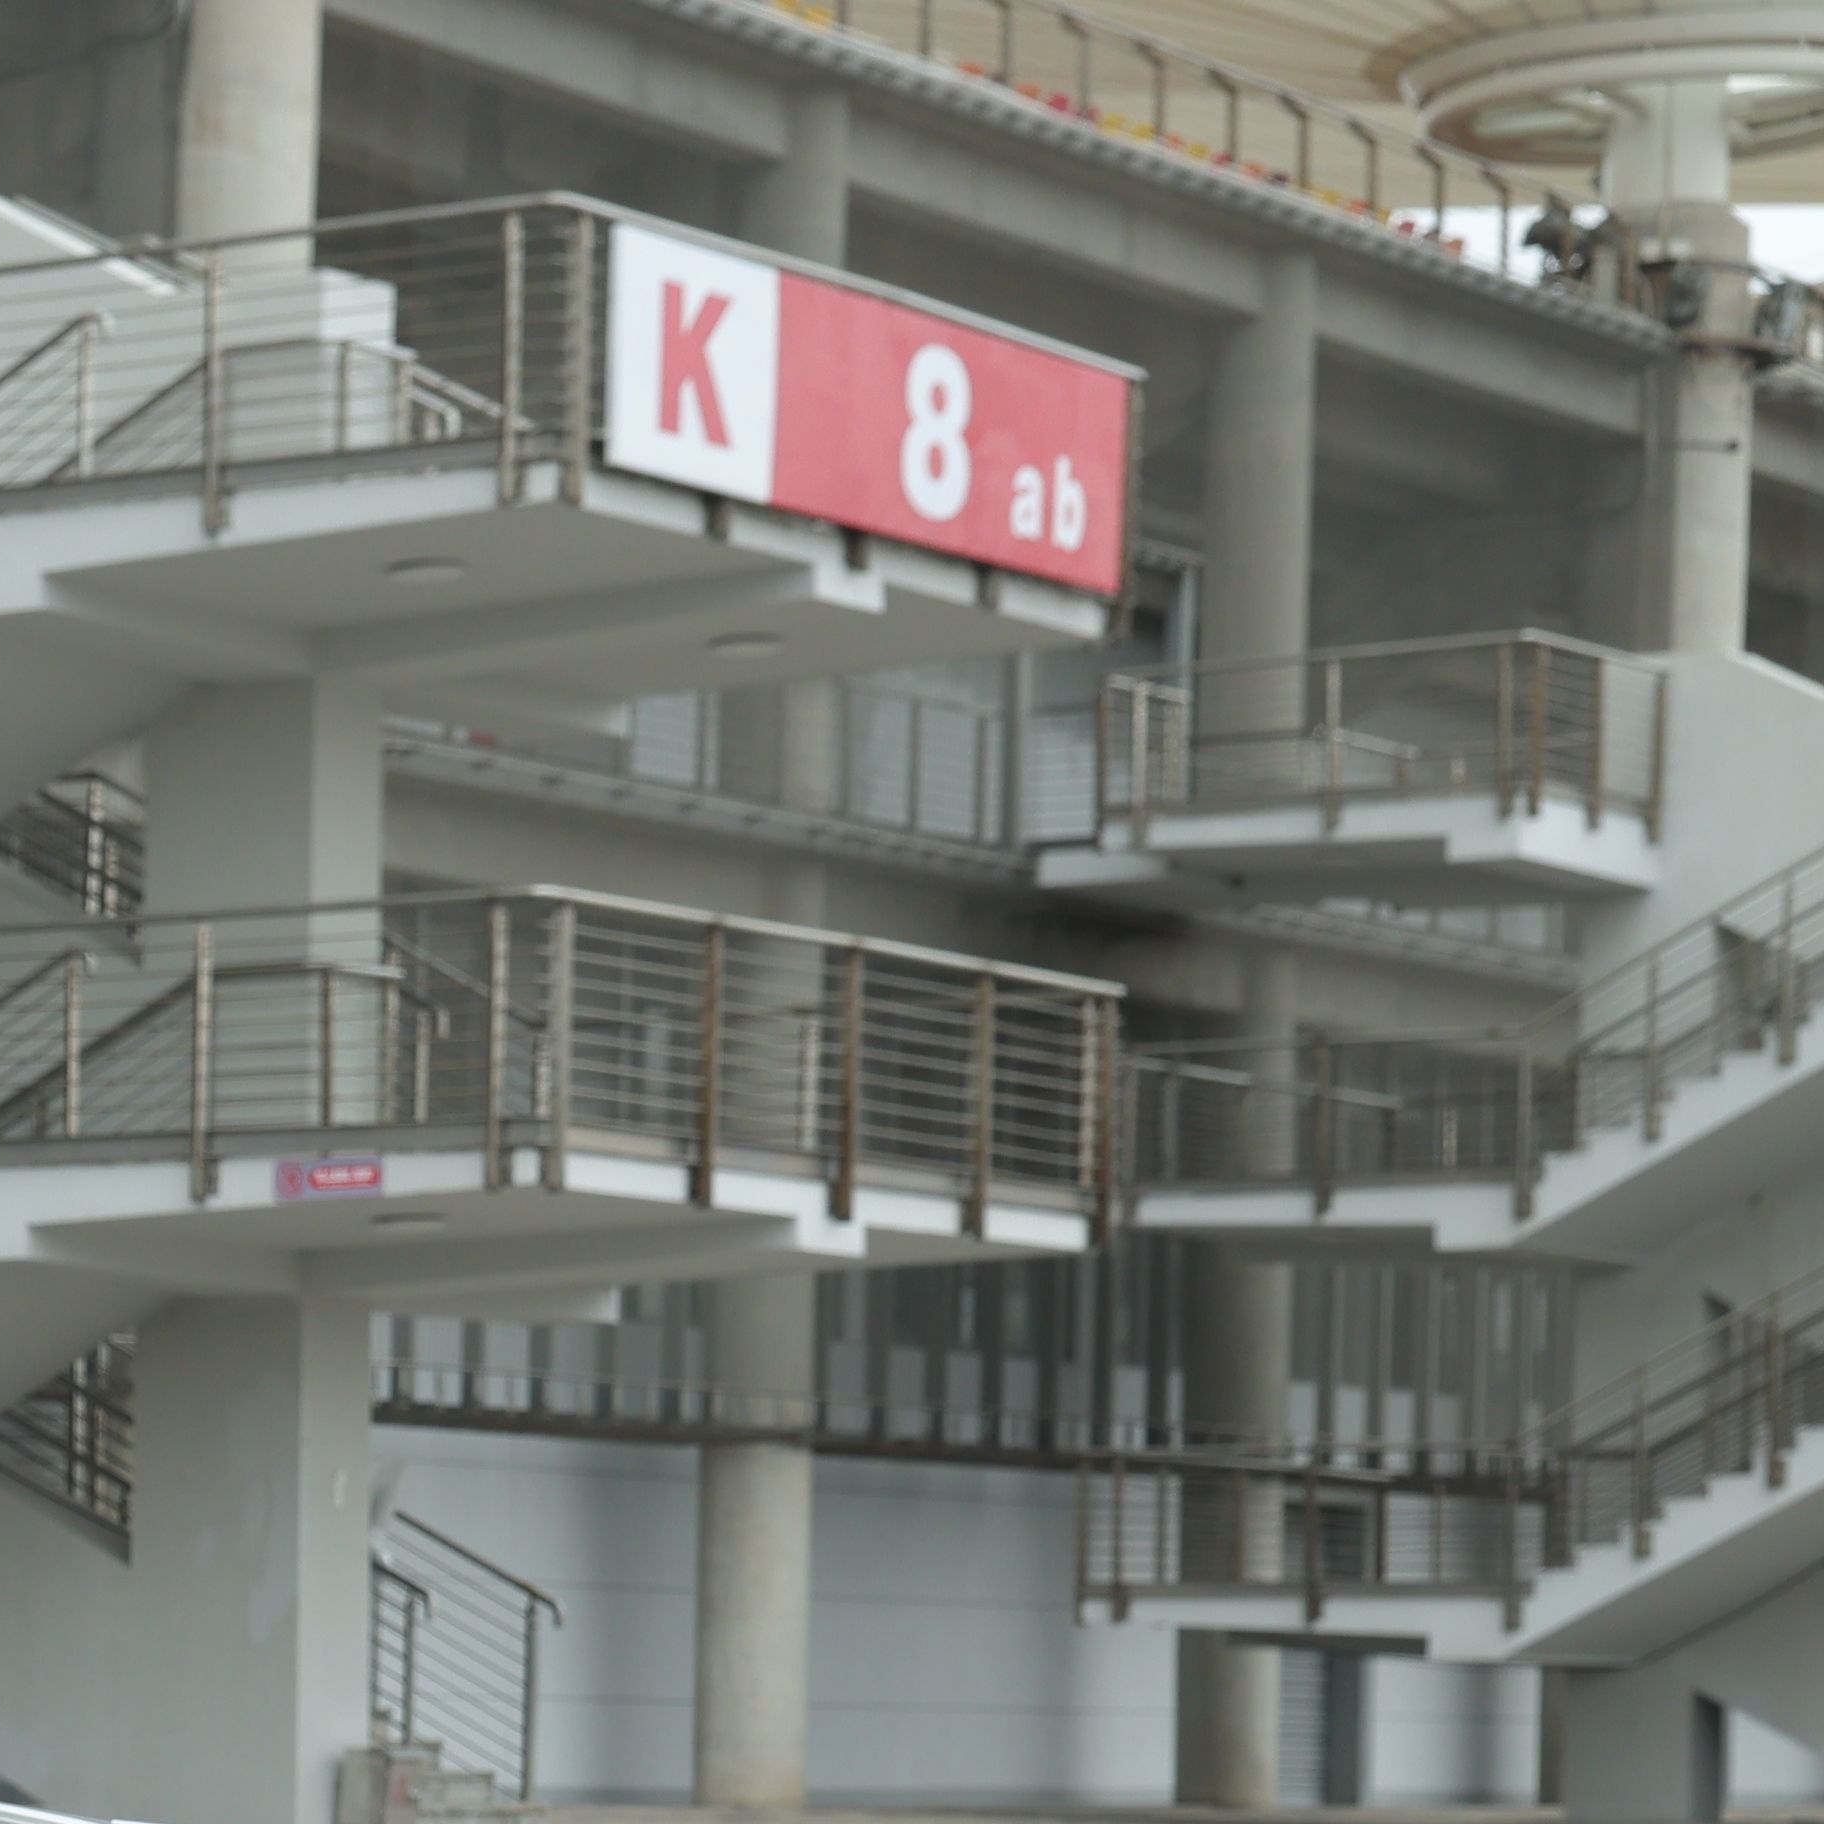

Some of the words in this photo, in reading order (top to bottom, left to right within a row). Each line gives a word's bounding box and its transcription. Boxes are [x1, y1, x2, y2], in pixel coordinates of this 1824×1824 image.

[657, 278, 734, 450] K
[899, 342, 972, 523] 8
[1008, 454, 1087, 553] ab
